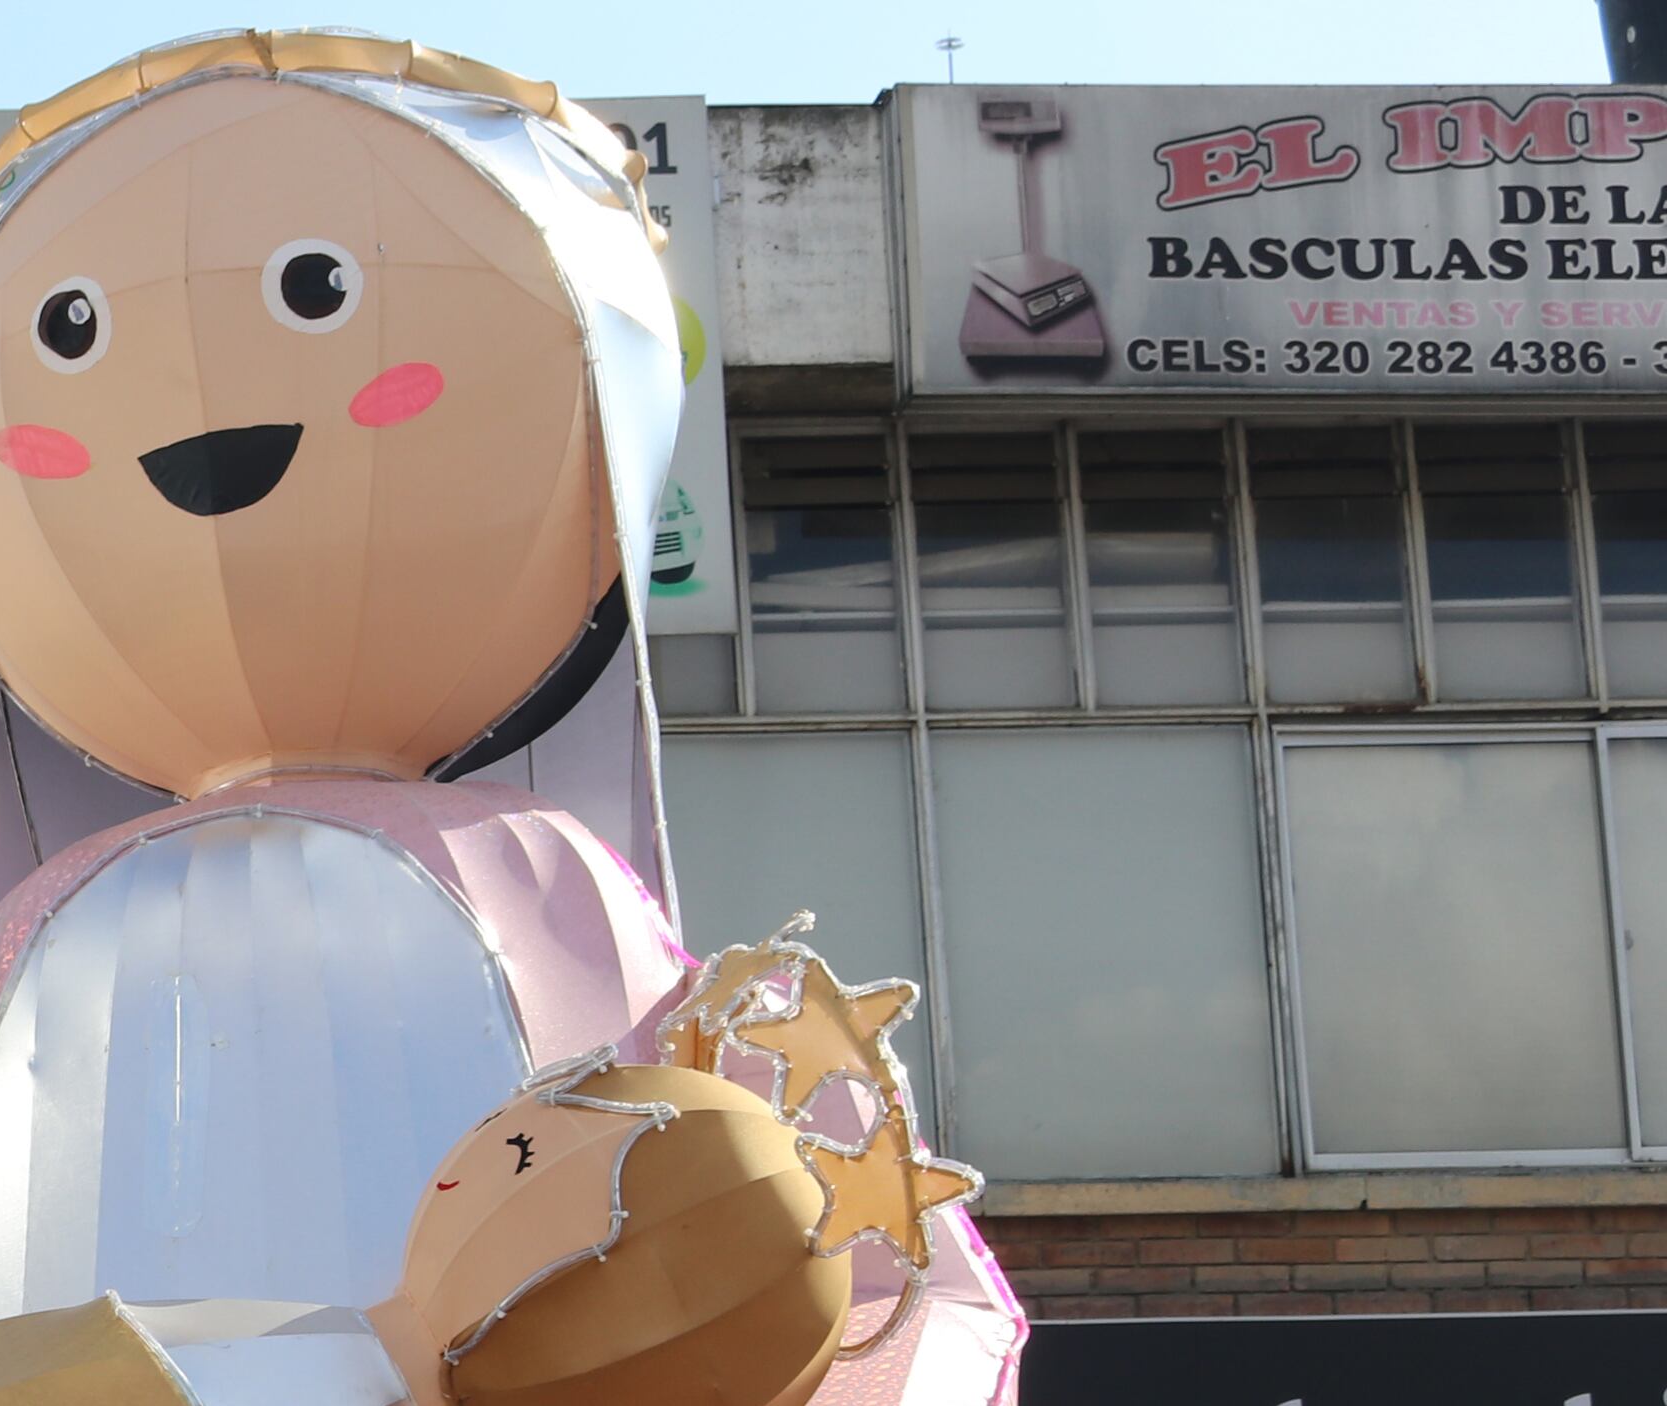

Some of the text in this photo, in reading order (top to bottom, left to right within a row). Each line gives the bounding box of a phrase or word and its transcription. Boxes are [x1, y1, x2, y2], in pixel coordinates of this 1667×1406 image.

[1155, 93, 1667, 211] EL IMP
[1498, 185, 1591, 225] DE
[1148, 237, 1667, 280] BASCULAS ELE
[1290, 301, 1666, 328] VENTAS Y SERV
[1126, 339, 1267, 375] CELS:
[1284, 340, 1370, 375] 320
[1387, 340, 1474, 375] 282
[1490, 340, 1607, 375] 4386
